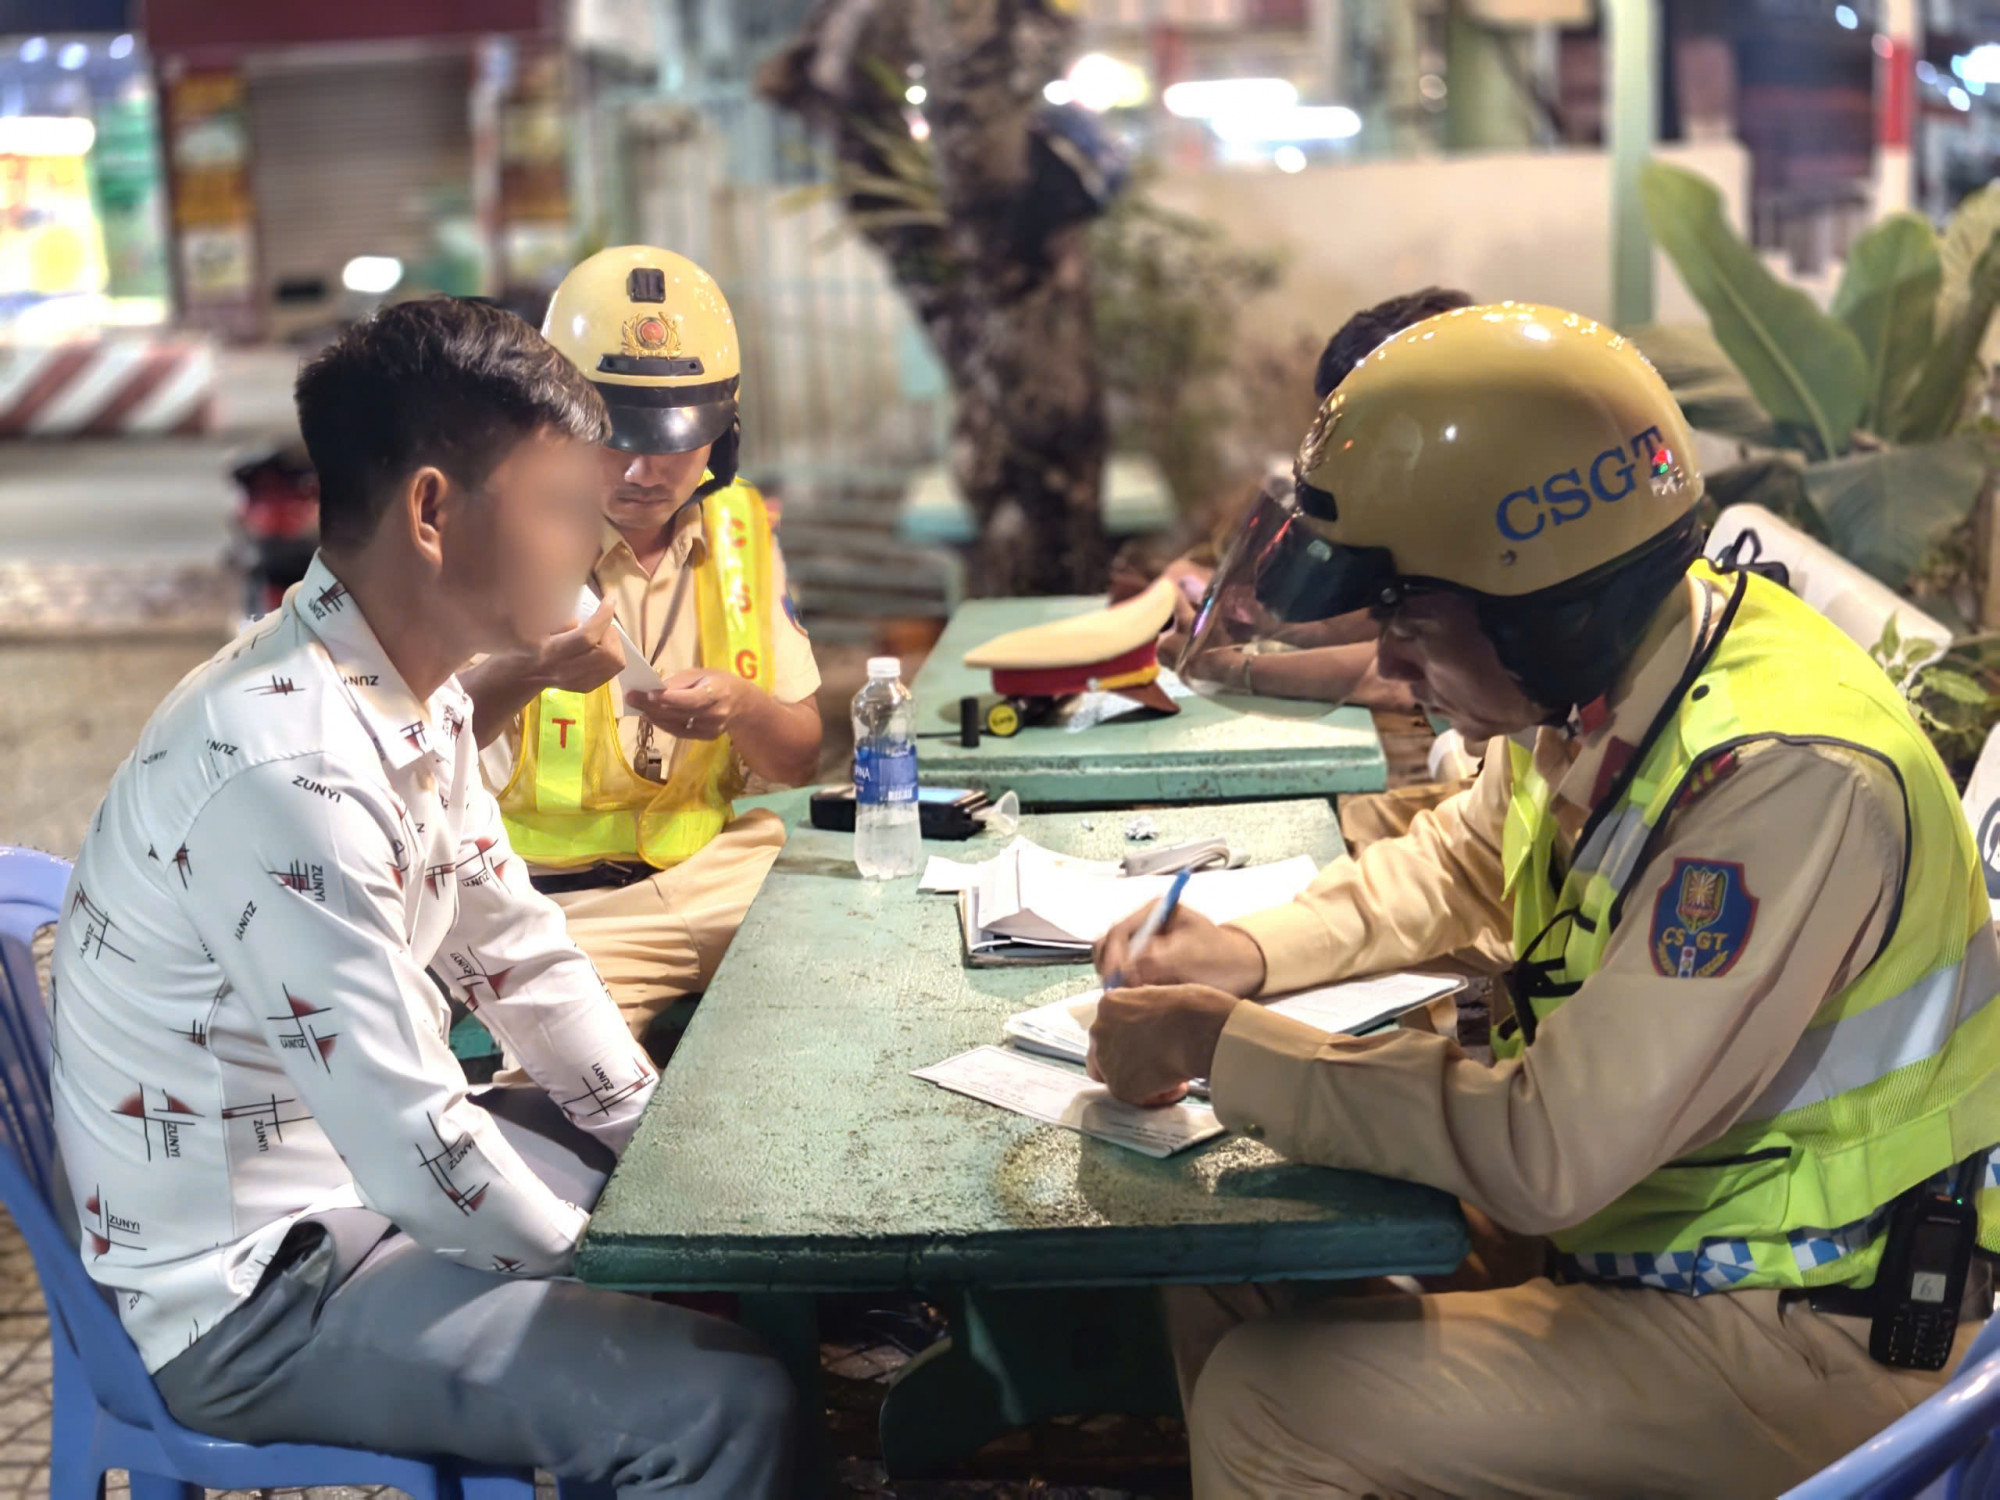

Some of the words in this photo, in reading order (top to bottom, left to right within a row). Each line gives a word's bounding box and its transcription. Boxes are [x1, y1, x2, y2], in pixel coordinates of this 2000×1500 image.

[1495, 425, 1668, 541] CSGT
[551, 717, 577, 749] T
[292, 775, 342, 803] ZUNYI
[311, 864, 326, 902] ZUNYI
[234, 900, 258, 941] ZUNYI
[592, 1062, 615, 1092] ZUNYI
[167, 1122, 181, 1158] ZUNYI
[253, 1119, 269, 1153] ZUNYI
[109, 1214, 141, 1231] ZUNYI
